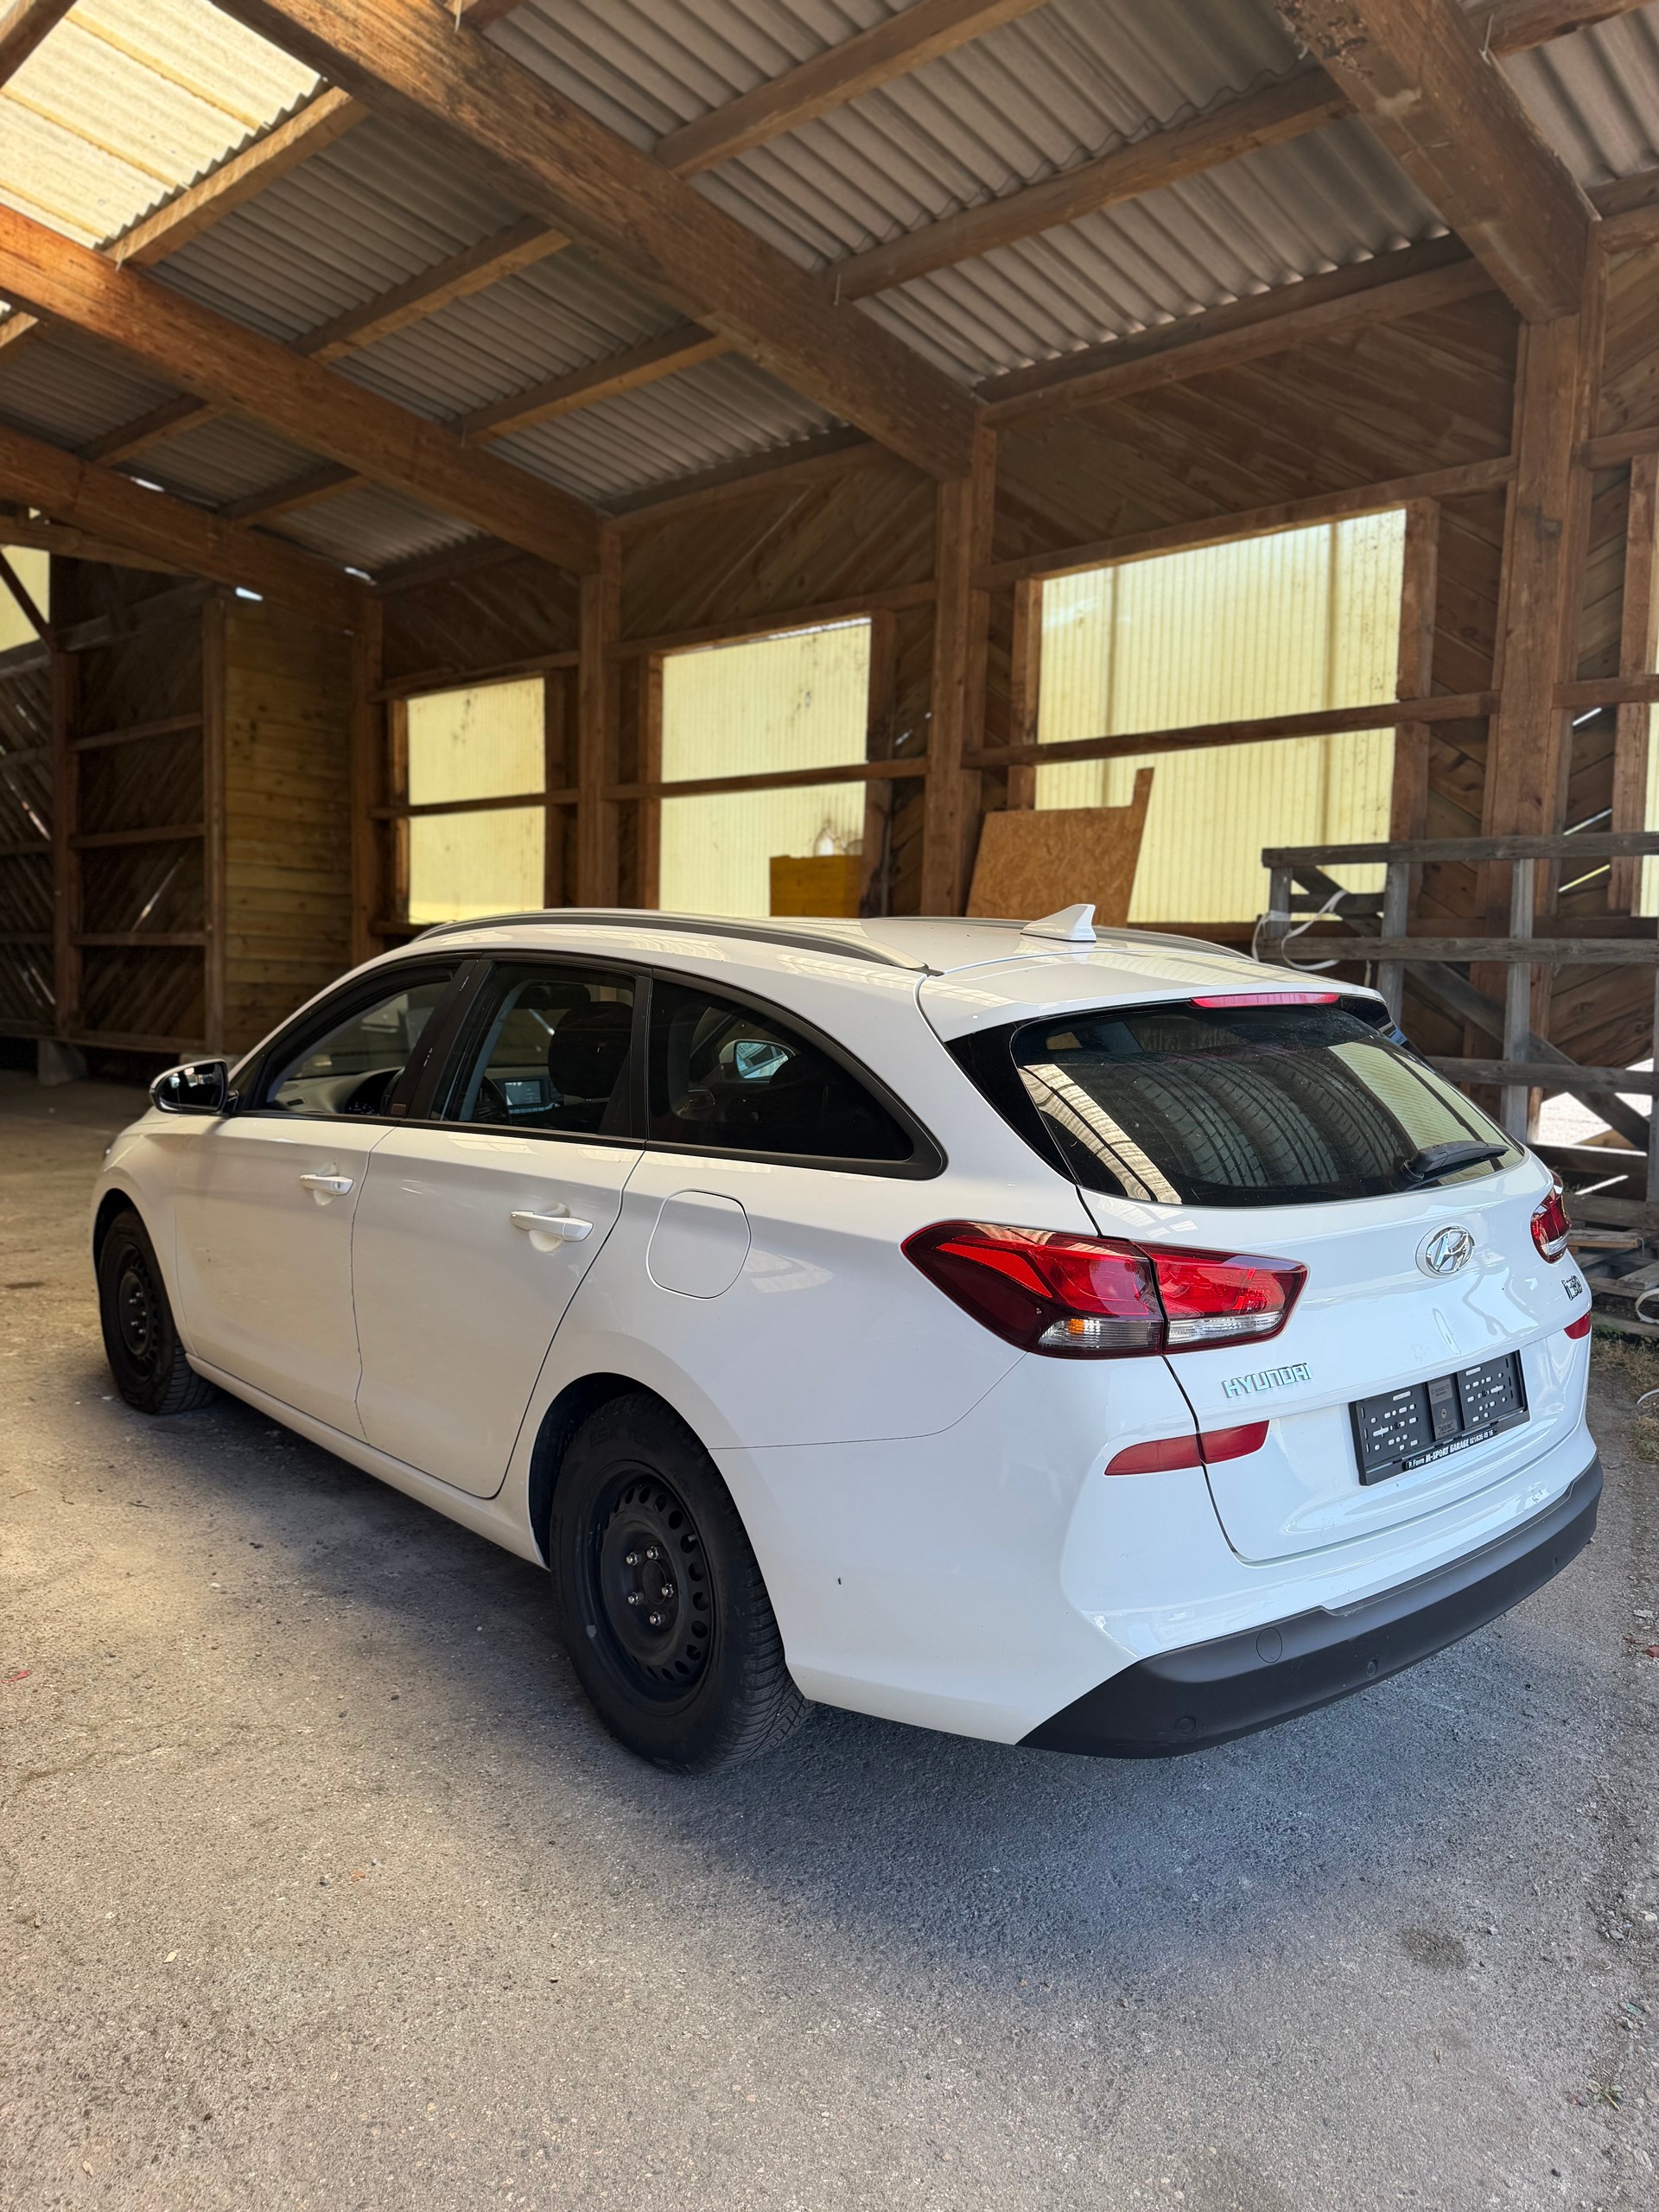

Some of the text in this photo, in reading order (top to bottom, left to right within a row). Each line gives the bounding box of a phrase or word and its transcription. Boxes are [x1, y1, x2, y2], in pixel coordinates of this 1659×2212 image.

[1221, 1363, 1313, 1398] HYUNDAI
[1425, 1446, 1449, 1463] M-SPORT
[1449, 1439, 1470, 1452] GARAGE
